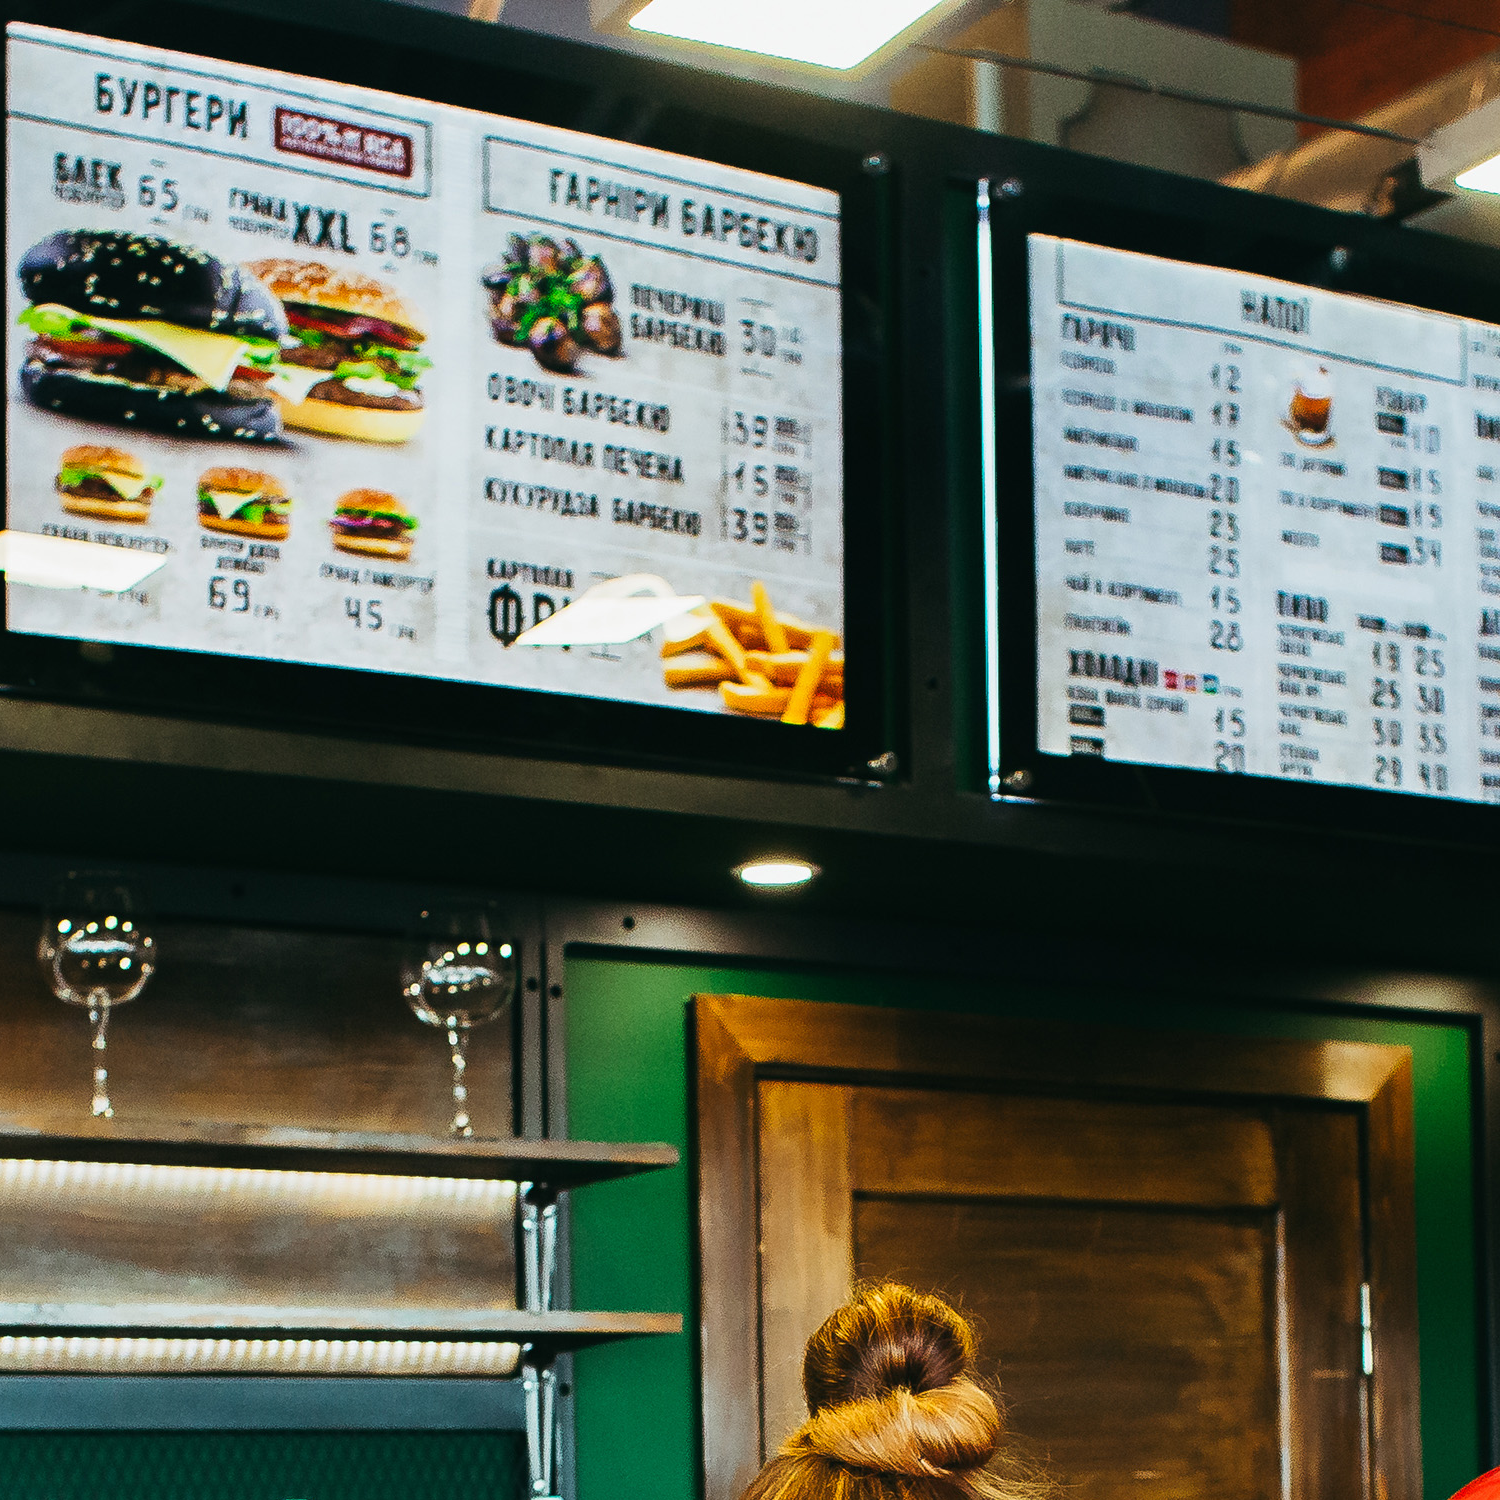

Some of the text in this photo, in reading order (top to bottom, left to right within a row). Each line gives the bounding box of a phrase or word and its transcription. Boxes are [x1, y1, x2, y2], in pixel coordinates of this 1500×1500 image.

[94, 71, 248, 138] БУРГЕРИ
[54, 151, 123, 196] БЛЕК
[138, 174, 178, 211] 65
[291, 202, 355, 254] XXL
[549, 167, 816, 263] ГАРНІРИ БАРБЕКЮ
[369, 221, 410, 257] 68
[562, 386, 669, 433] БАРБЕКЮ
[207, 575, 249, 612] 69
[344, 597, 383, 631] 45
[486, 586, 572, 649] ФР
